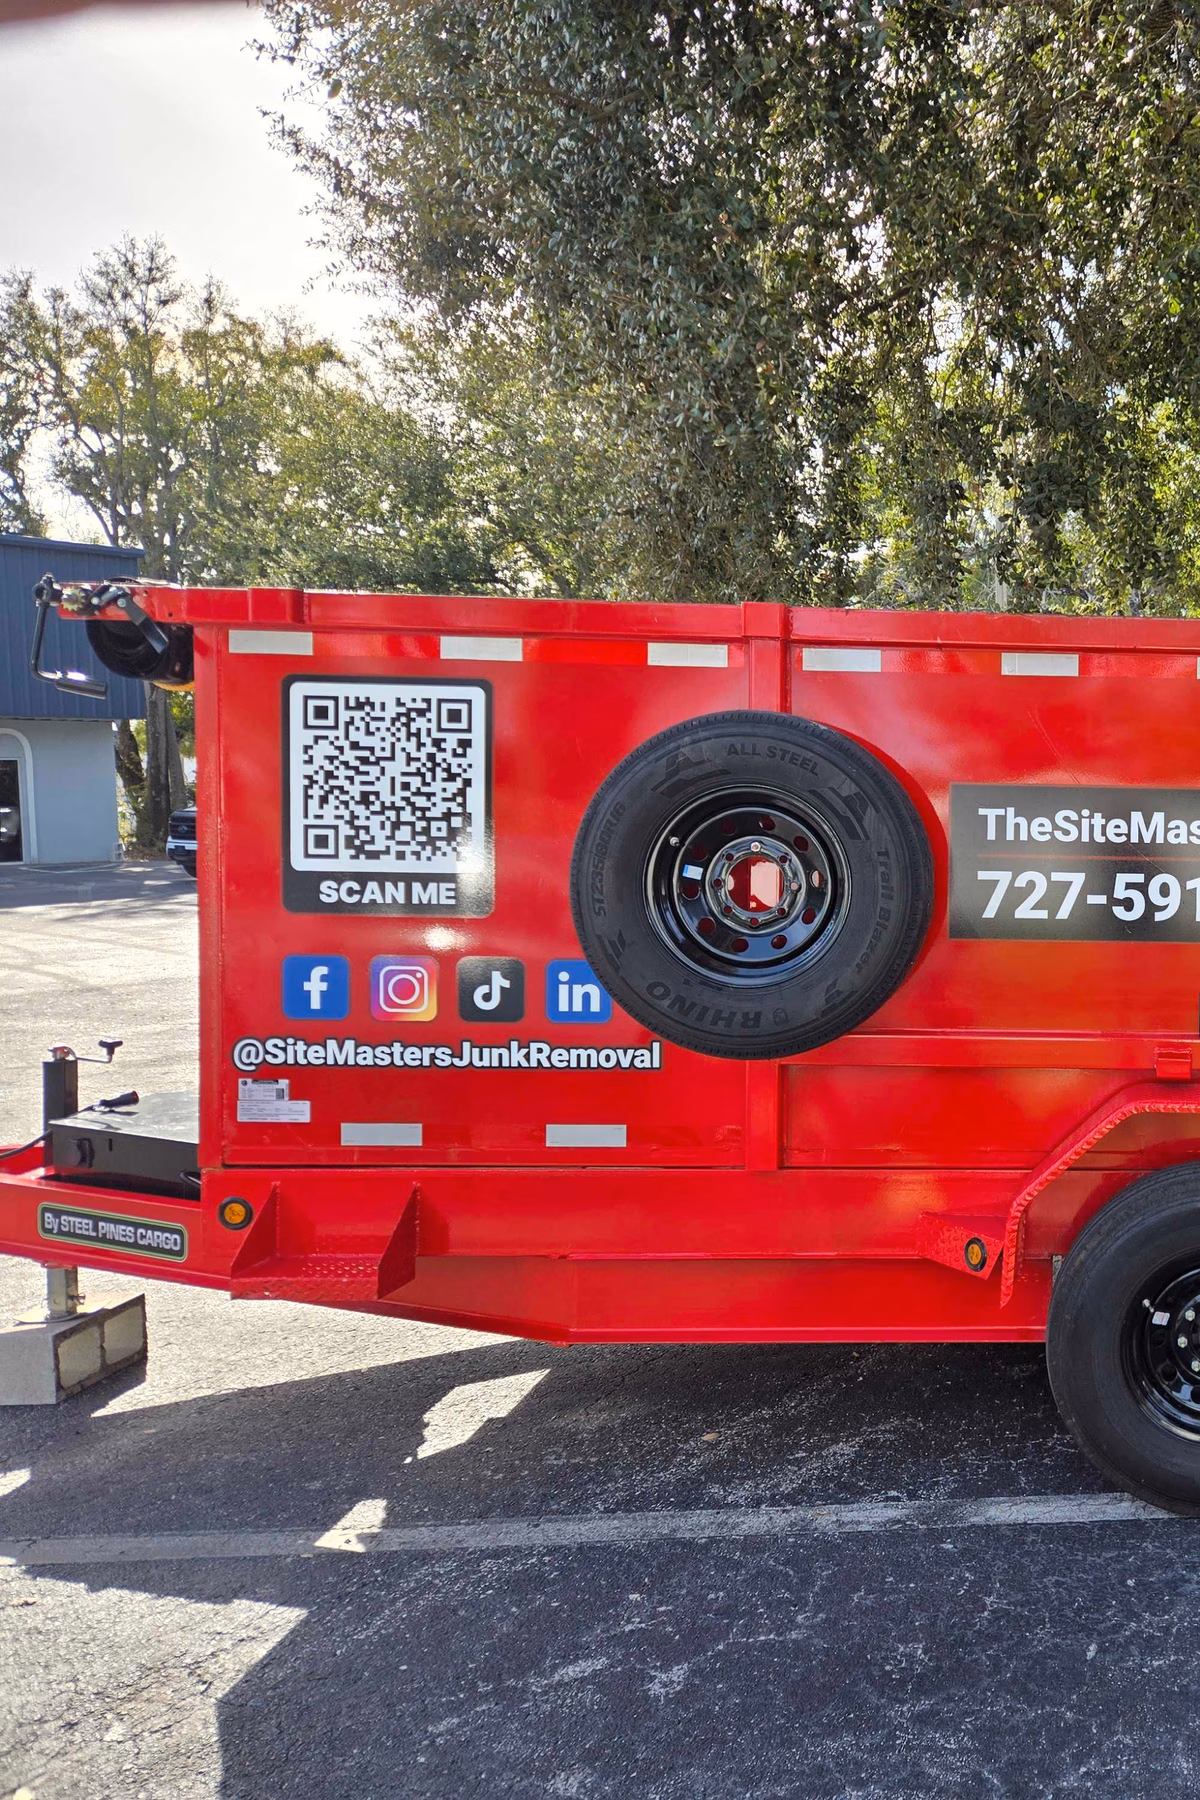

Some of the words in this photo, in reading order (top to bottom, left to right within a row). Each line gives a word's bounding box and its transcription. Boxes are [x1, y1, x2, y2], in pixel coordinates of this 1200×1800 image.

[727, 743, 761, 756] ALL
[766, 745, 819, 776] STEEL
[319, 881, 404, 904] SCAN
[412, 882, 456, 905] ME
[646, 981, 762, 1029] RHINO
[233, 1038, 661, 1071] @SiteMastersJunkRemoval
[44, 1212, 59, 1233] By
[60, 1215, 97, 1237] STEEL
[98, 1222, 135, 1243] PINES
[136, 1228, 181, 1251] CARGO
